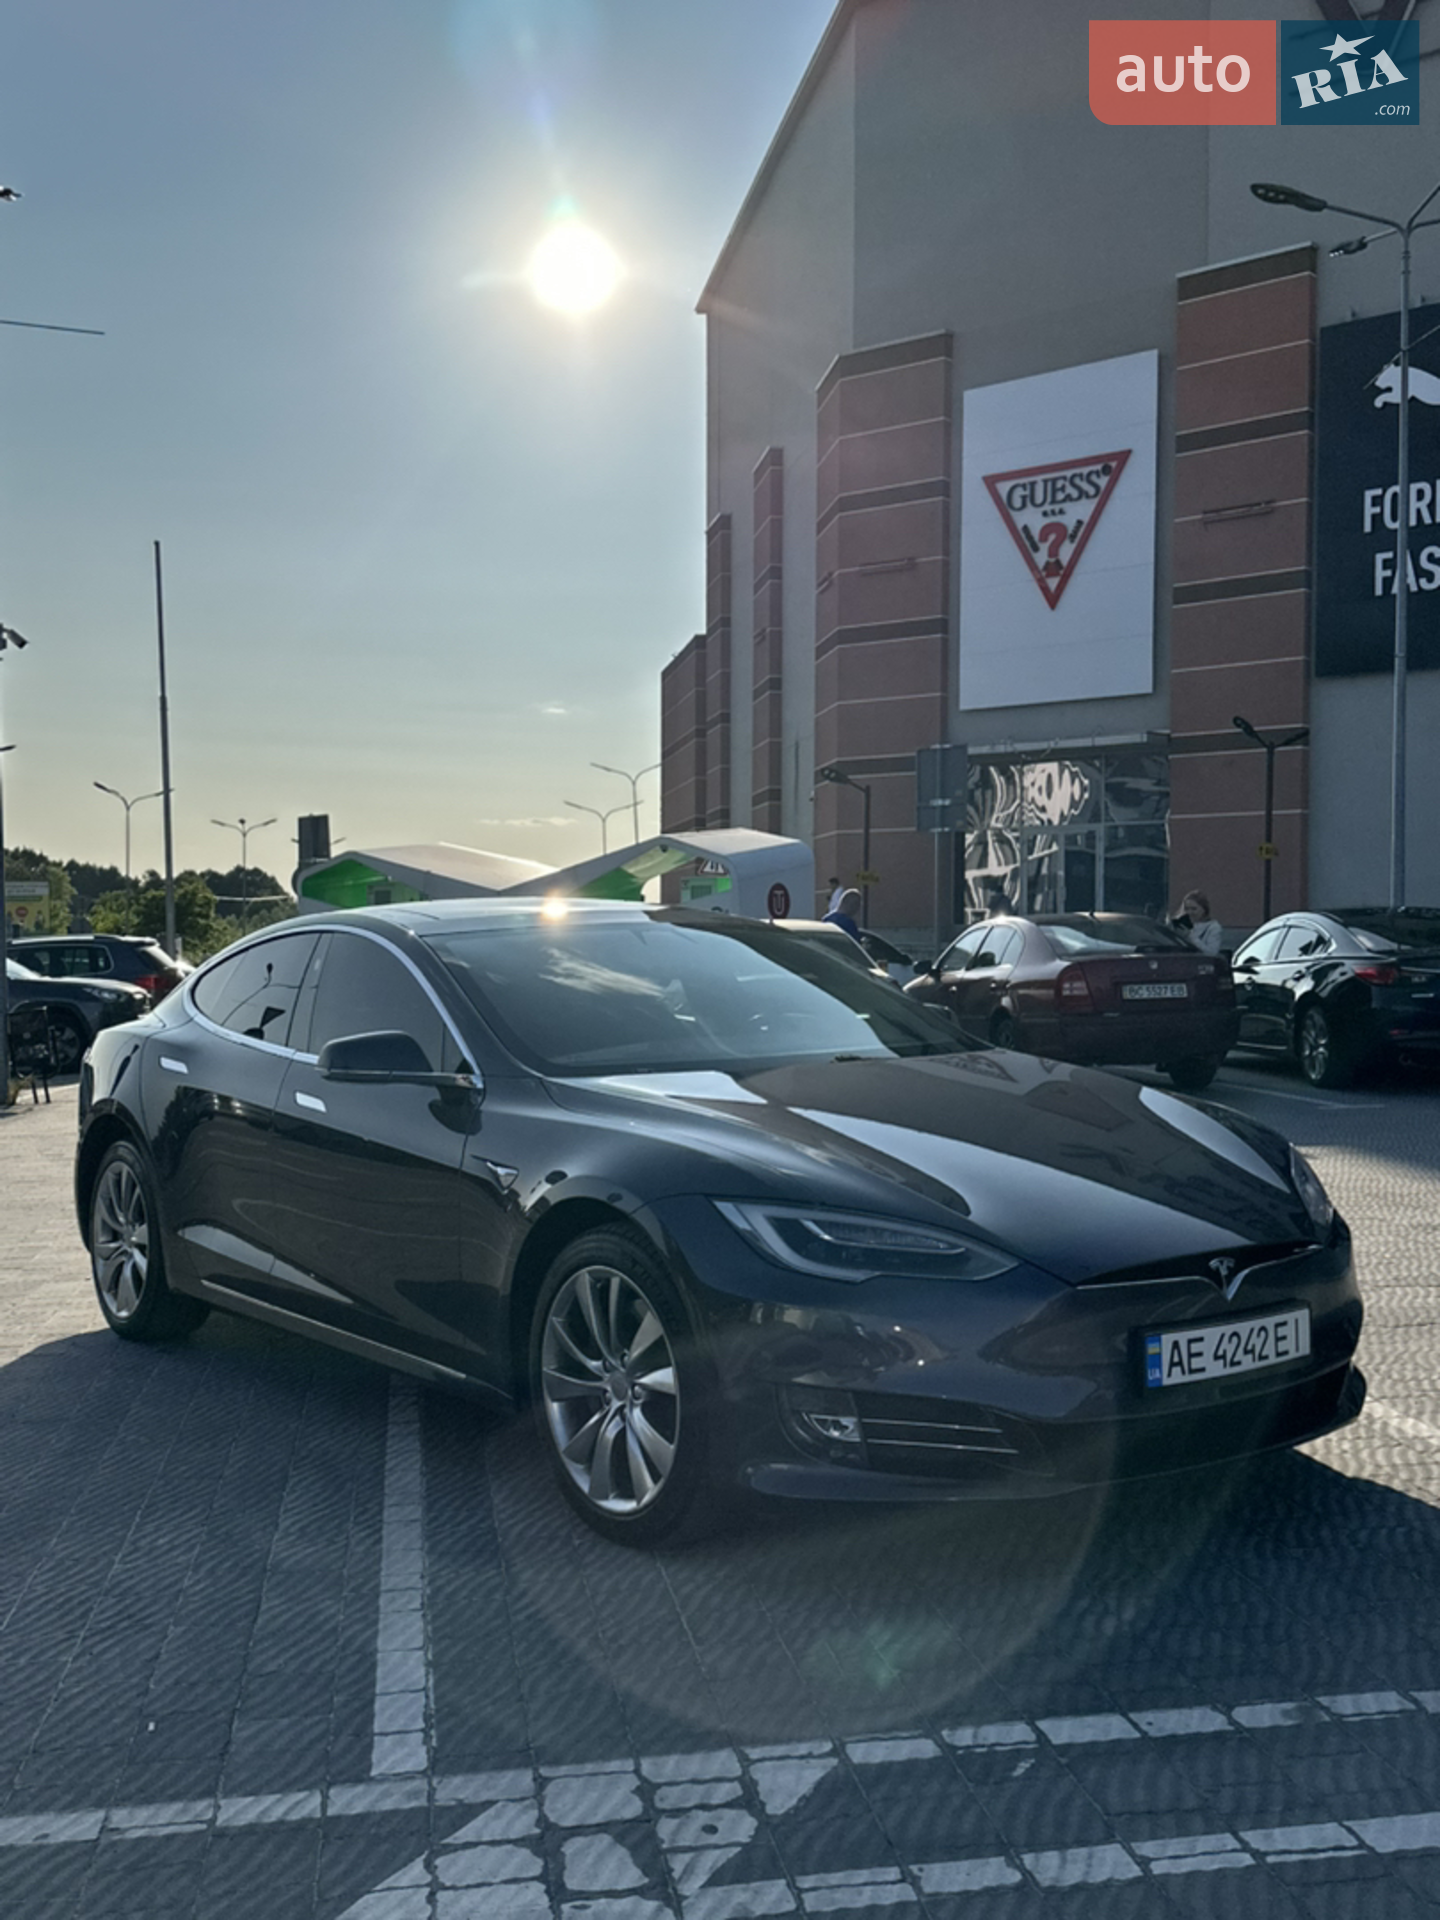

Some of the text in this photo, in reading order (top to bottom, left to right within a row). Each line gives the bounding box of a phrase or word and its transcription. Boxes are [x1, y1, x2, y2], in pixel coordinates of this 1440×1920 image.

[1006, 469, 1101, 512] GUESS
[1363, 479, 1440, 533] FOR
[1167, 1317, 1300, 1378] AE 4242 EI
